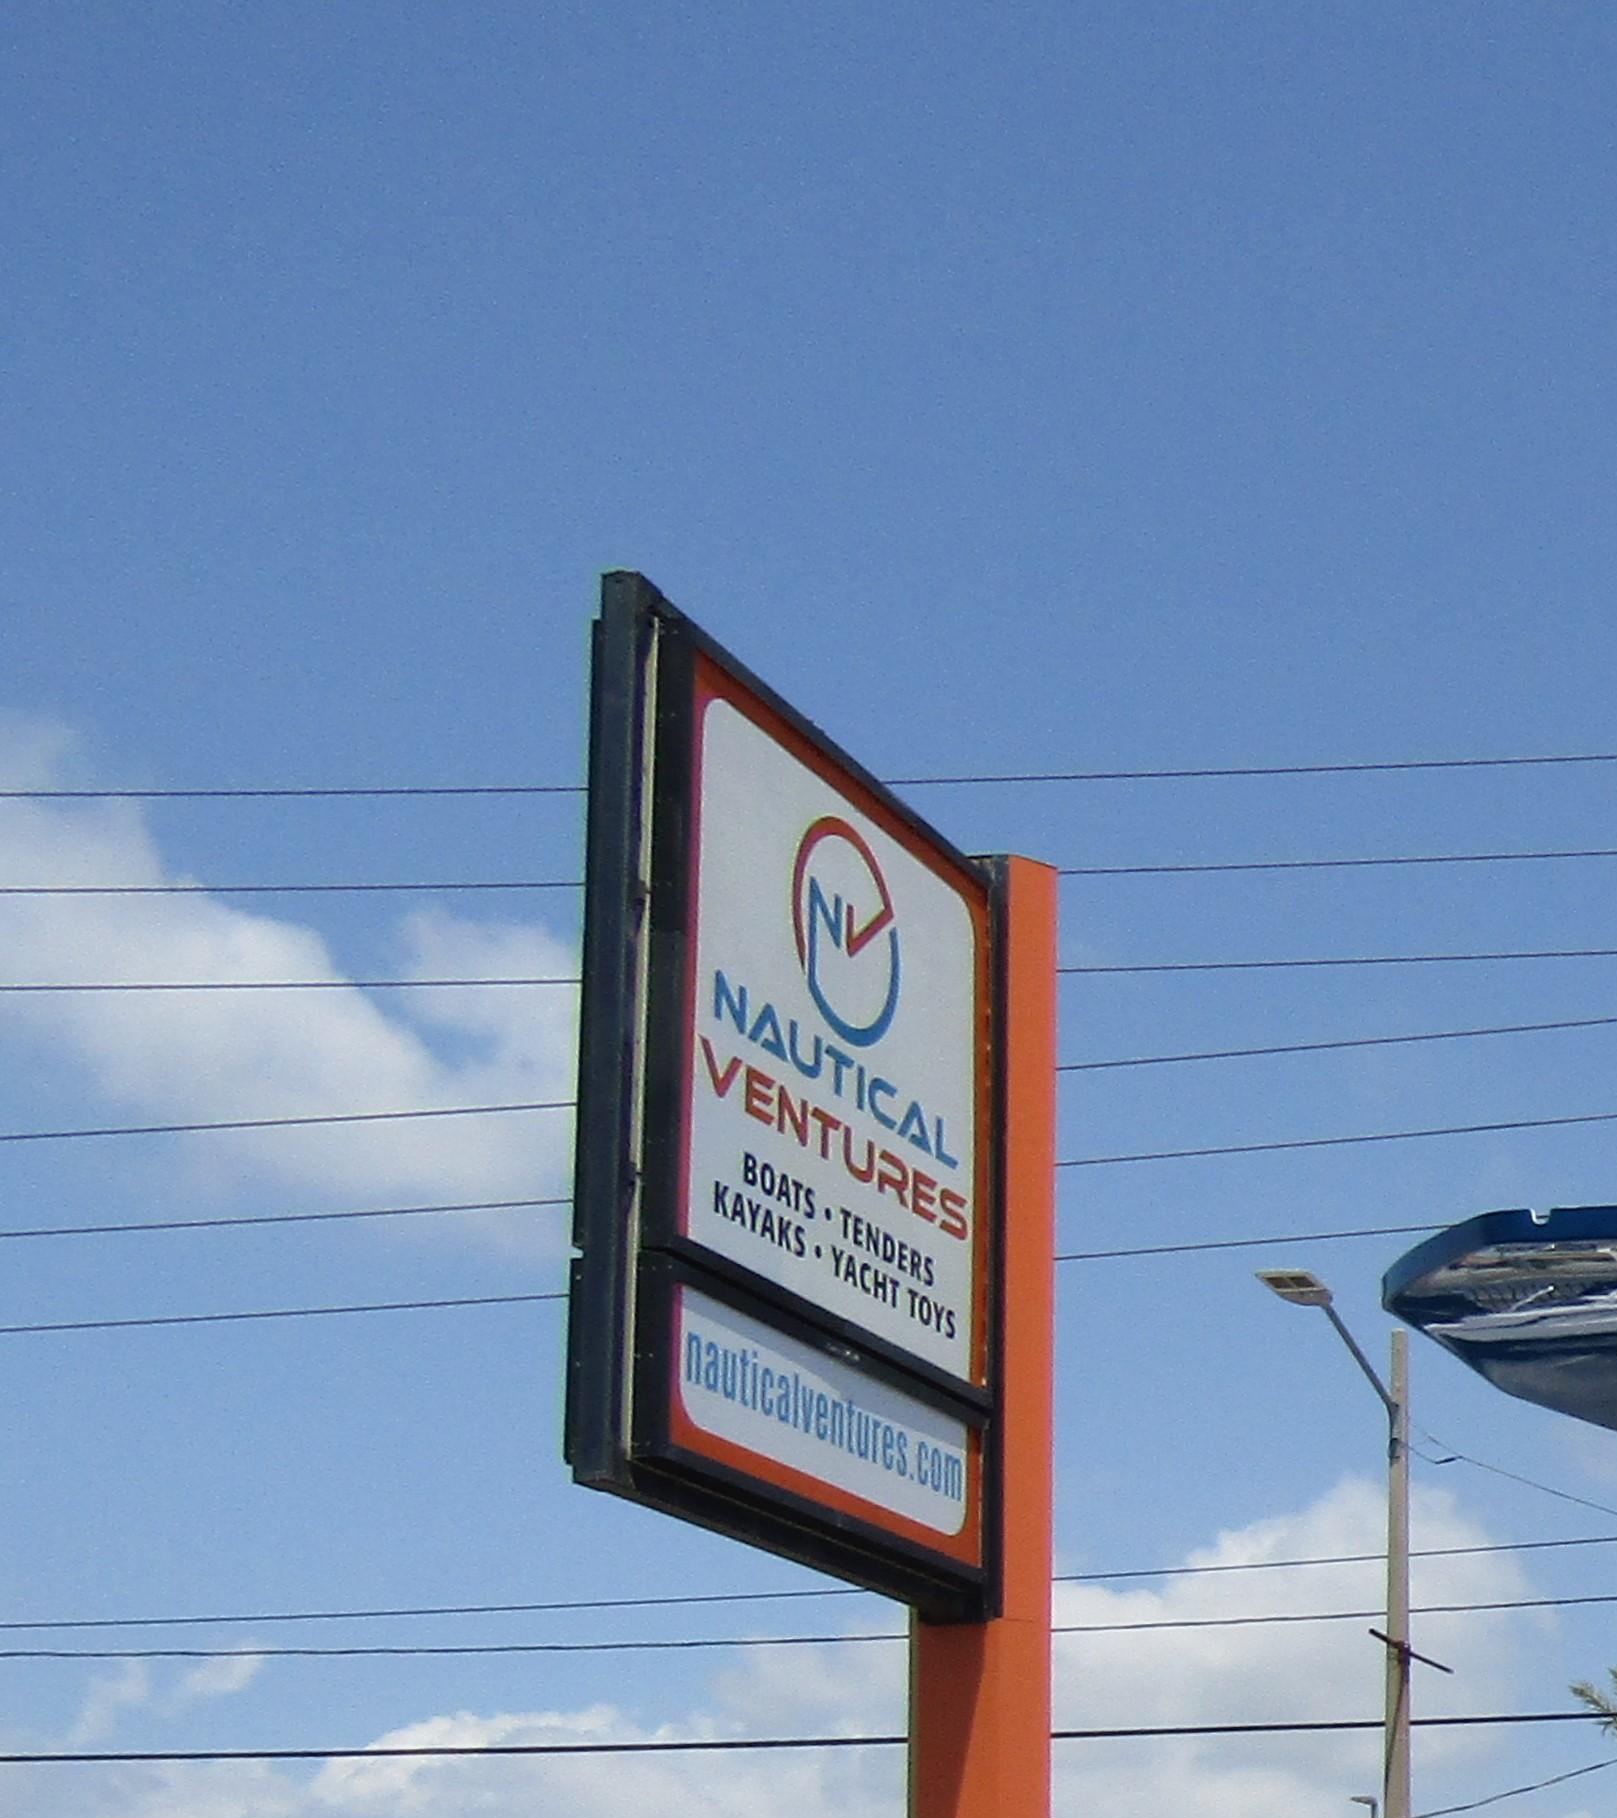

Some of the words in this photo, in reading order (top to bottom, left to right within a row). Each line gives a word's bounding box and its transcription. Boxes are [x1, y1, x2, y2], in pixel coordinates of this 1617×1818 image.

[698, 1033, 969, 1241] VENTURES
[713, 969, 958, 1170] NAUTICAL
[713, 1181, 806, 1258] KAYAKS
[831, 1245, 900, 1308] YACHT
[907, 1288, 956, 1339] TOYS
[743, 1152, 816, 1219] BOATS
[840, 1206, 934, 1287] TENDERS
[686, 1331, 962, 1501] nauticalventures.com
